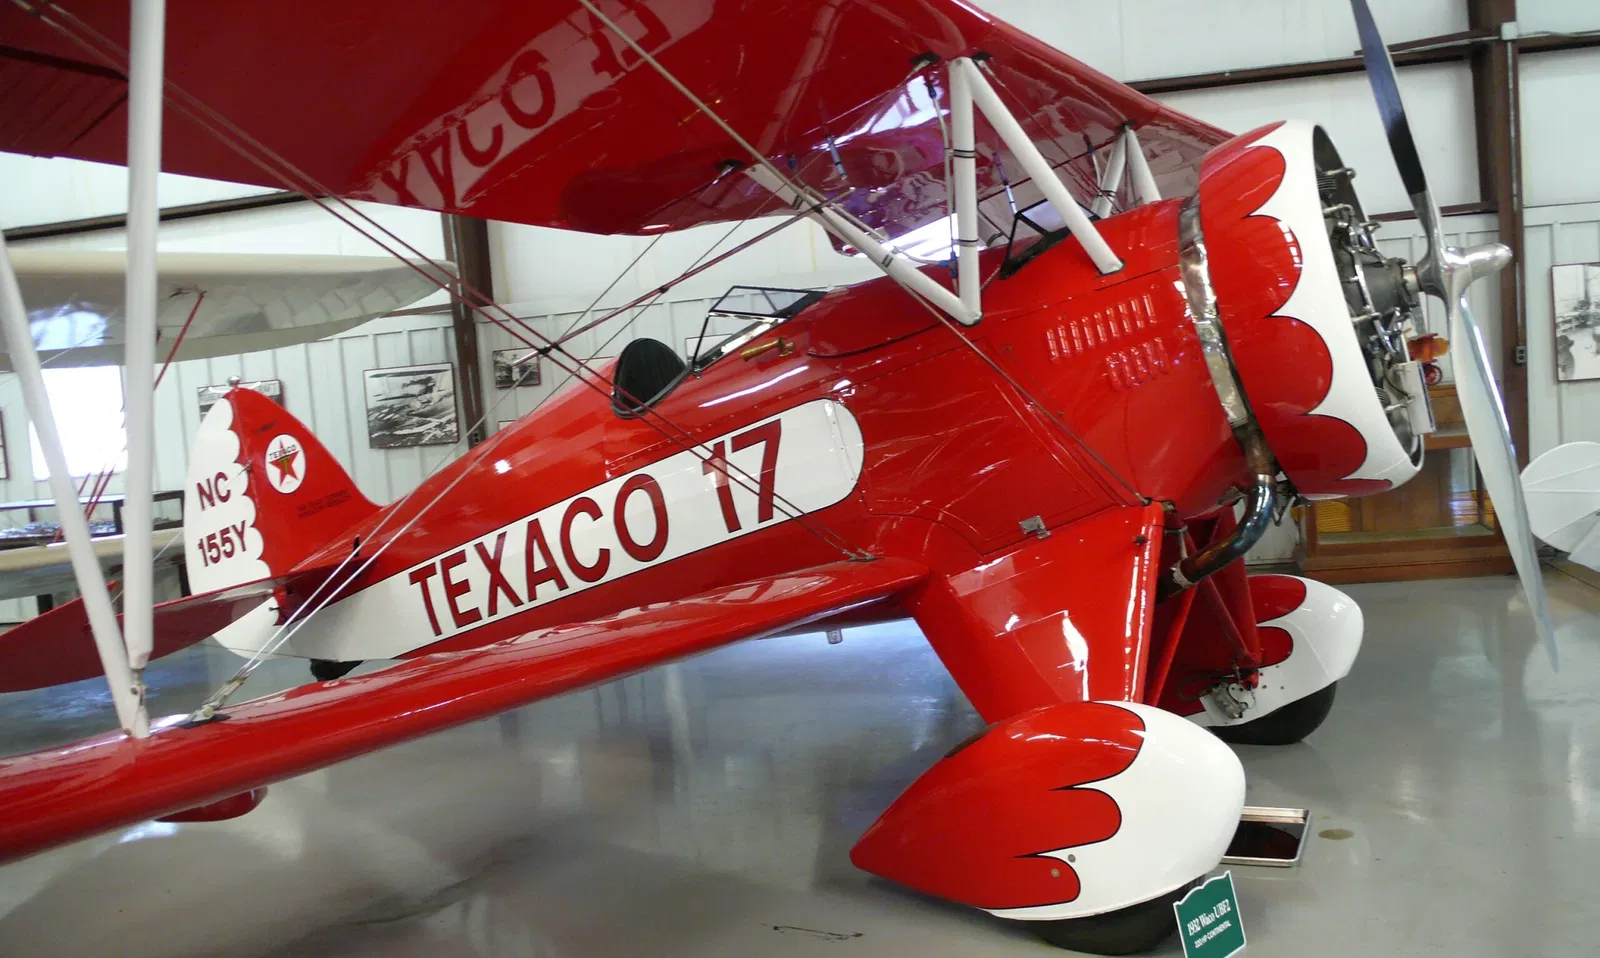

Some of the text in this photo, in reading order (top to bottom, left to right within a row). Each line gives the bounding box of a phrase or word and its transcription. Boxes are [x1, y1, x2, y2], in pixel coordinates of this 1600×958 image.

[268, 444, 297, 460] TEXACO
[196, 471, 231, 511] NC
[198, 520, 247, 567] 155Y
[409, 418, 782, 637] TEXACO 17
[1187, 918, 1201, 936] 1932
[1199, 913, 1215, 927] Waco
